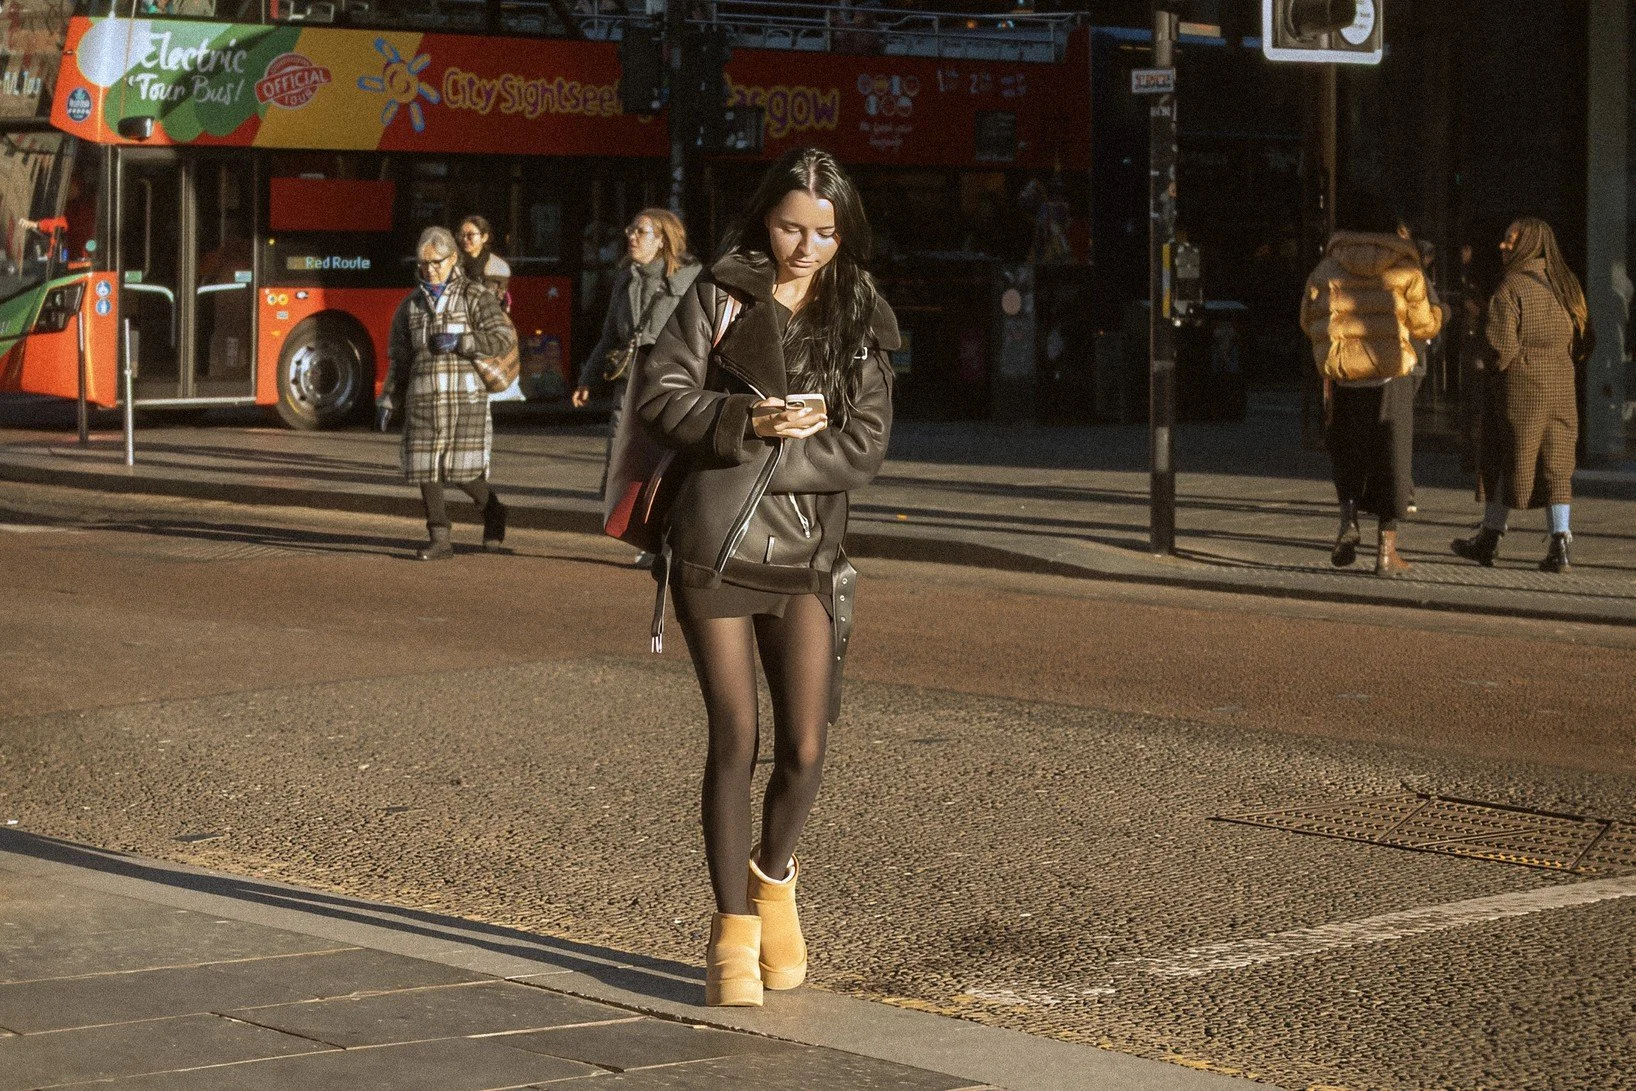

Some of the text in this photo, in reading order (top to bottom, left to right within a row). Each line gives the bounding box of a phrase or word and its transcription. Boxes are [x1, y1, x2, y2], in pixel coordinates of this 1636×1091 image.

[141, 31, 247, 73] Electric
[128, 73, 186, 101] Tour
[263, 70, 326, 98] OFFICIAL
[442, 66, 653, 122] City Sightsee
[305, 256, 371, 269] Red Route
